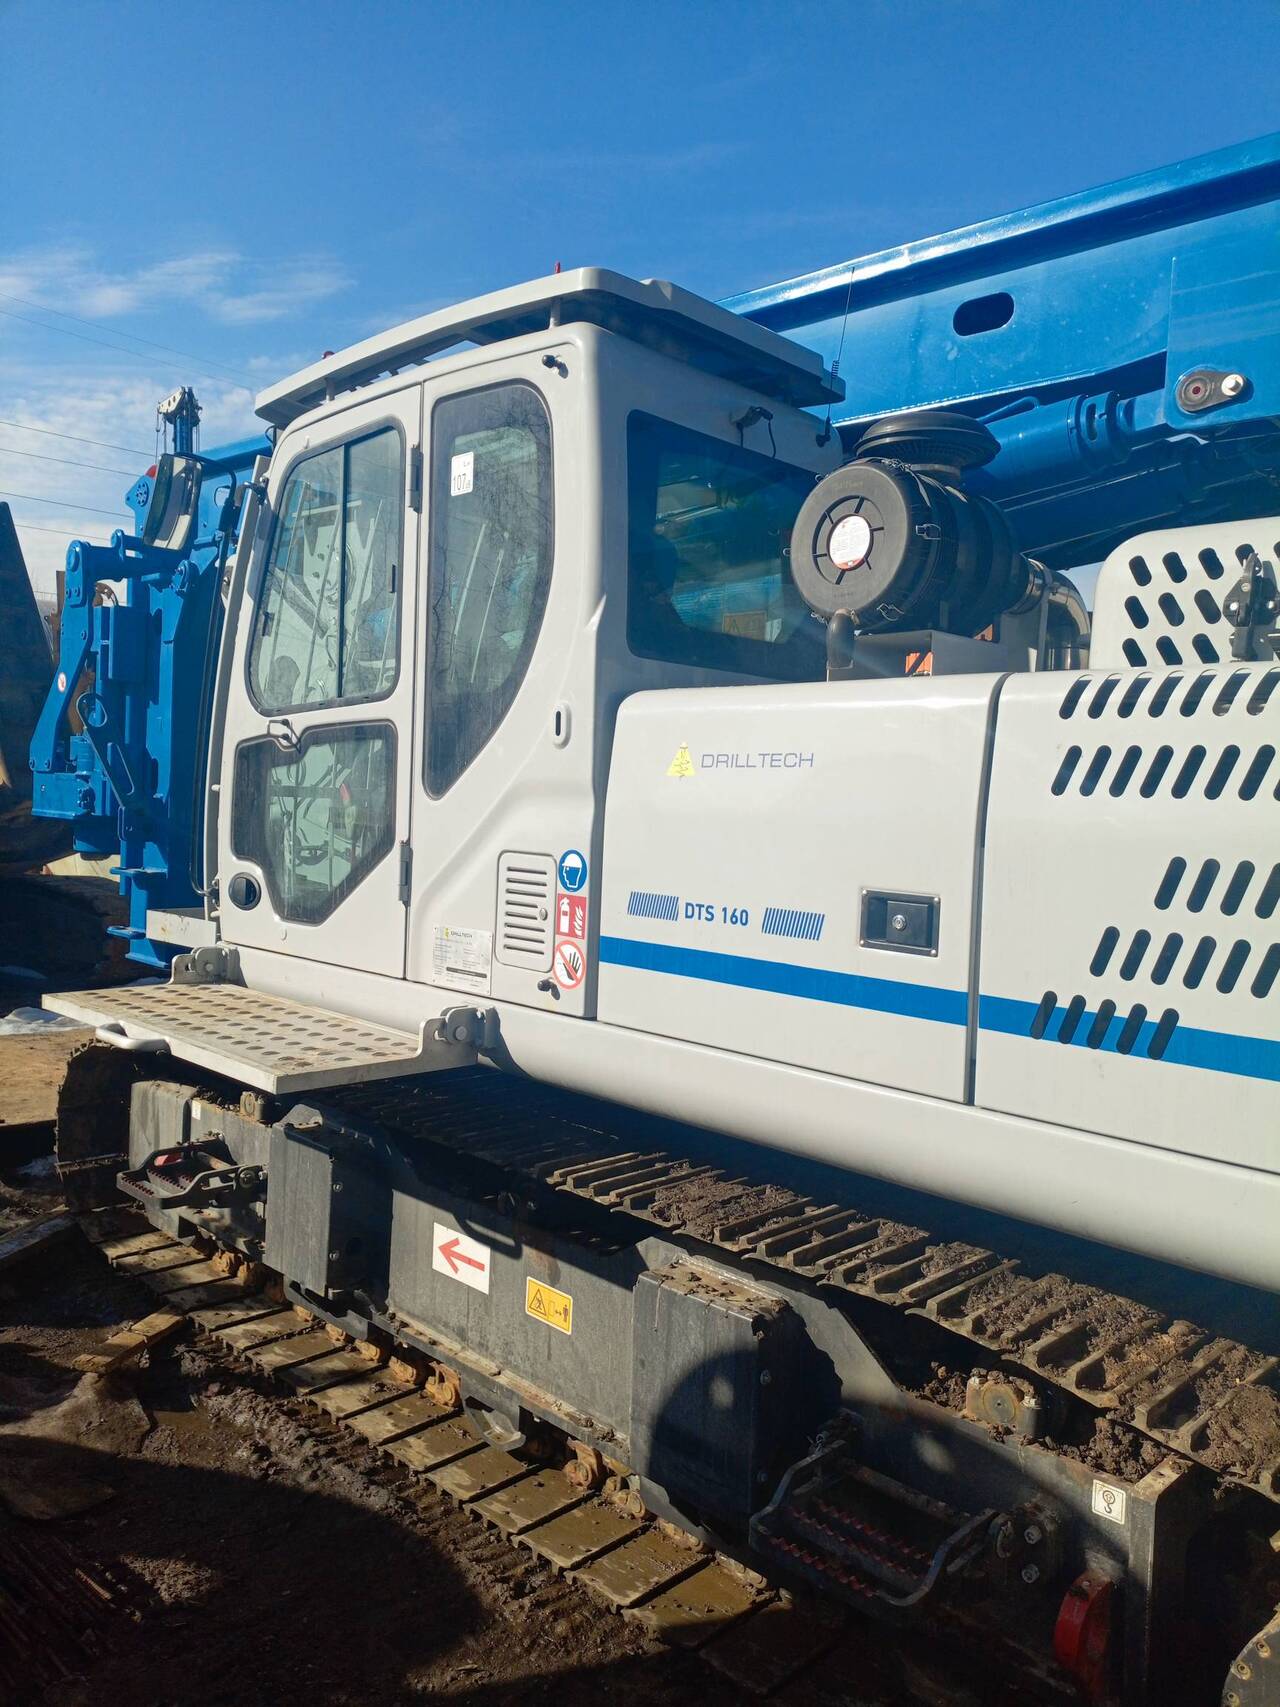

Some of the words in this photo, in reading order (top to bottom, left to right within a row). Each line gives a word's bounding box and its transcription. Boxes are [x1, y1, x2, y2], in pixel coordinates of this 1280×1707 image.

[701, 752, 815, 768] DRILLTECH
[684, 901, 715, 922] DTS
[721, 905, 749, 927] 160
